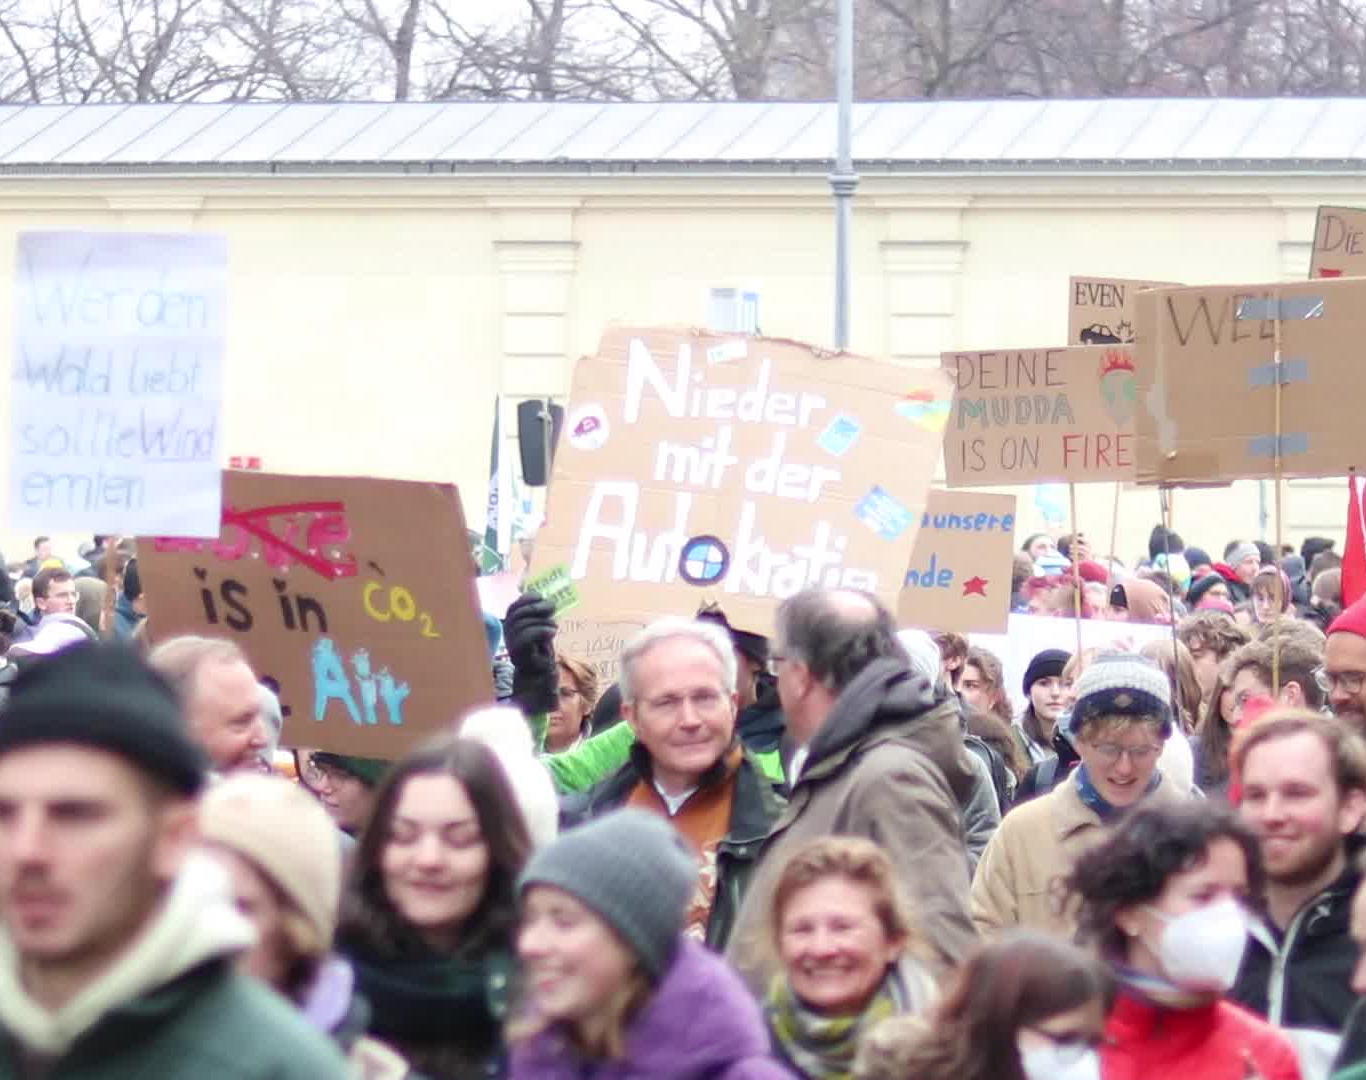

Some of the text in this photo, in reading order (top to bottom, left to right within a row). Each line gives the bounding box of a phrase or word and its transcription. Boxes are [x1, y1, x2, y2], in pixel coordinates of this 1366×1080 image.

[1074, 281, 1126, 308] EVEN
[623, 337, 826, 428] Nieder
[955, 350, 1068, 390] DEINE
[956, 393, 1076, 430] MUDDA
[653, 425, 841, 501] mit der
[961, 433, 1133, 472] IS ON FIRE
[193, 566, 254, 633] is
[272, 577, 329, 633] in
[311, 636, 412, 726] Air
